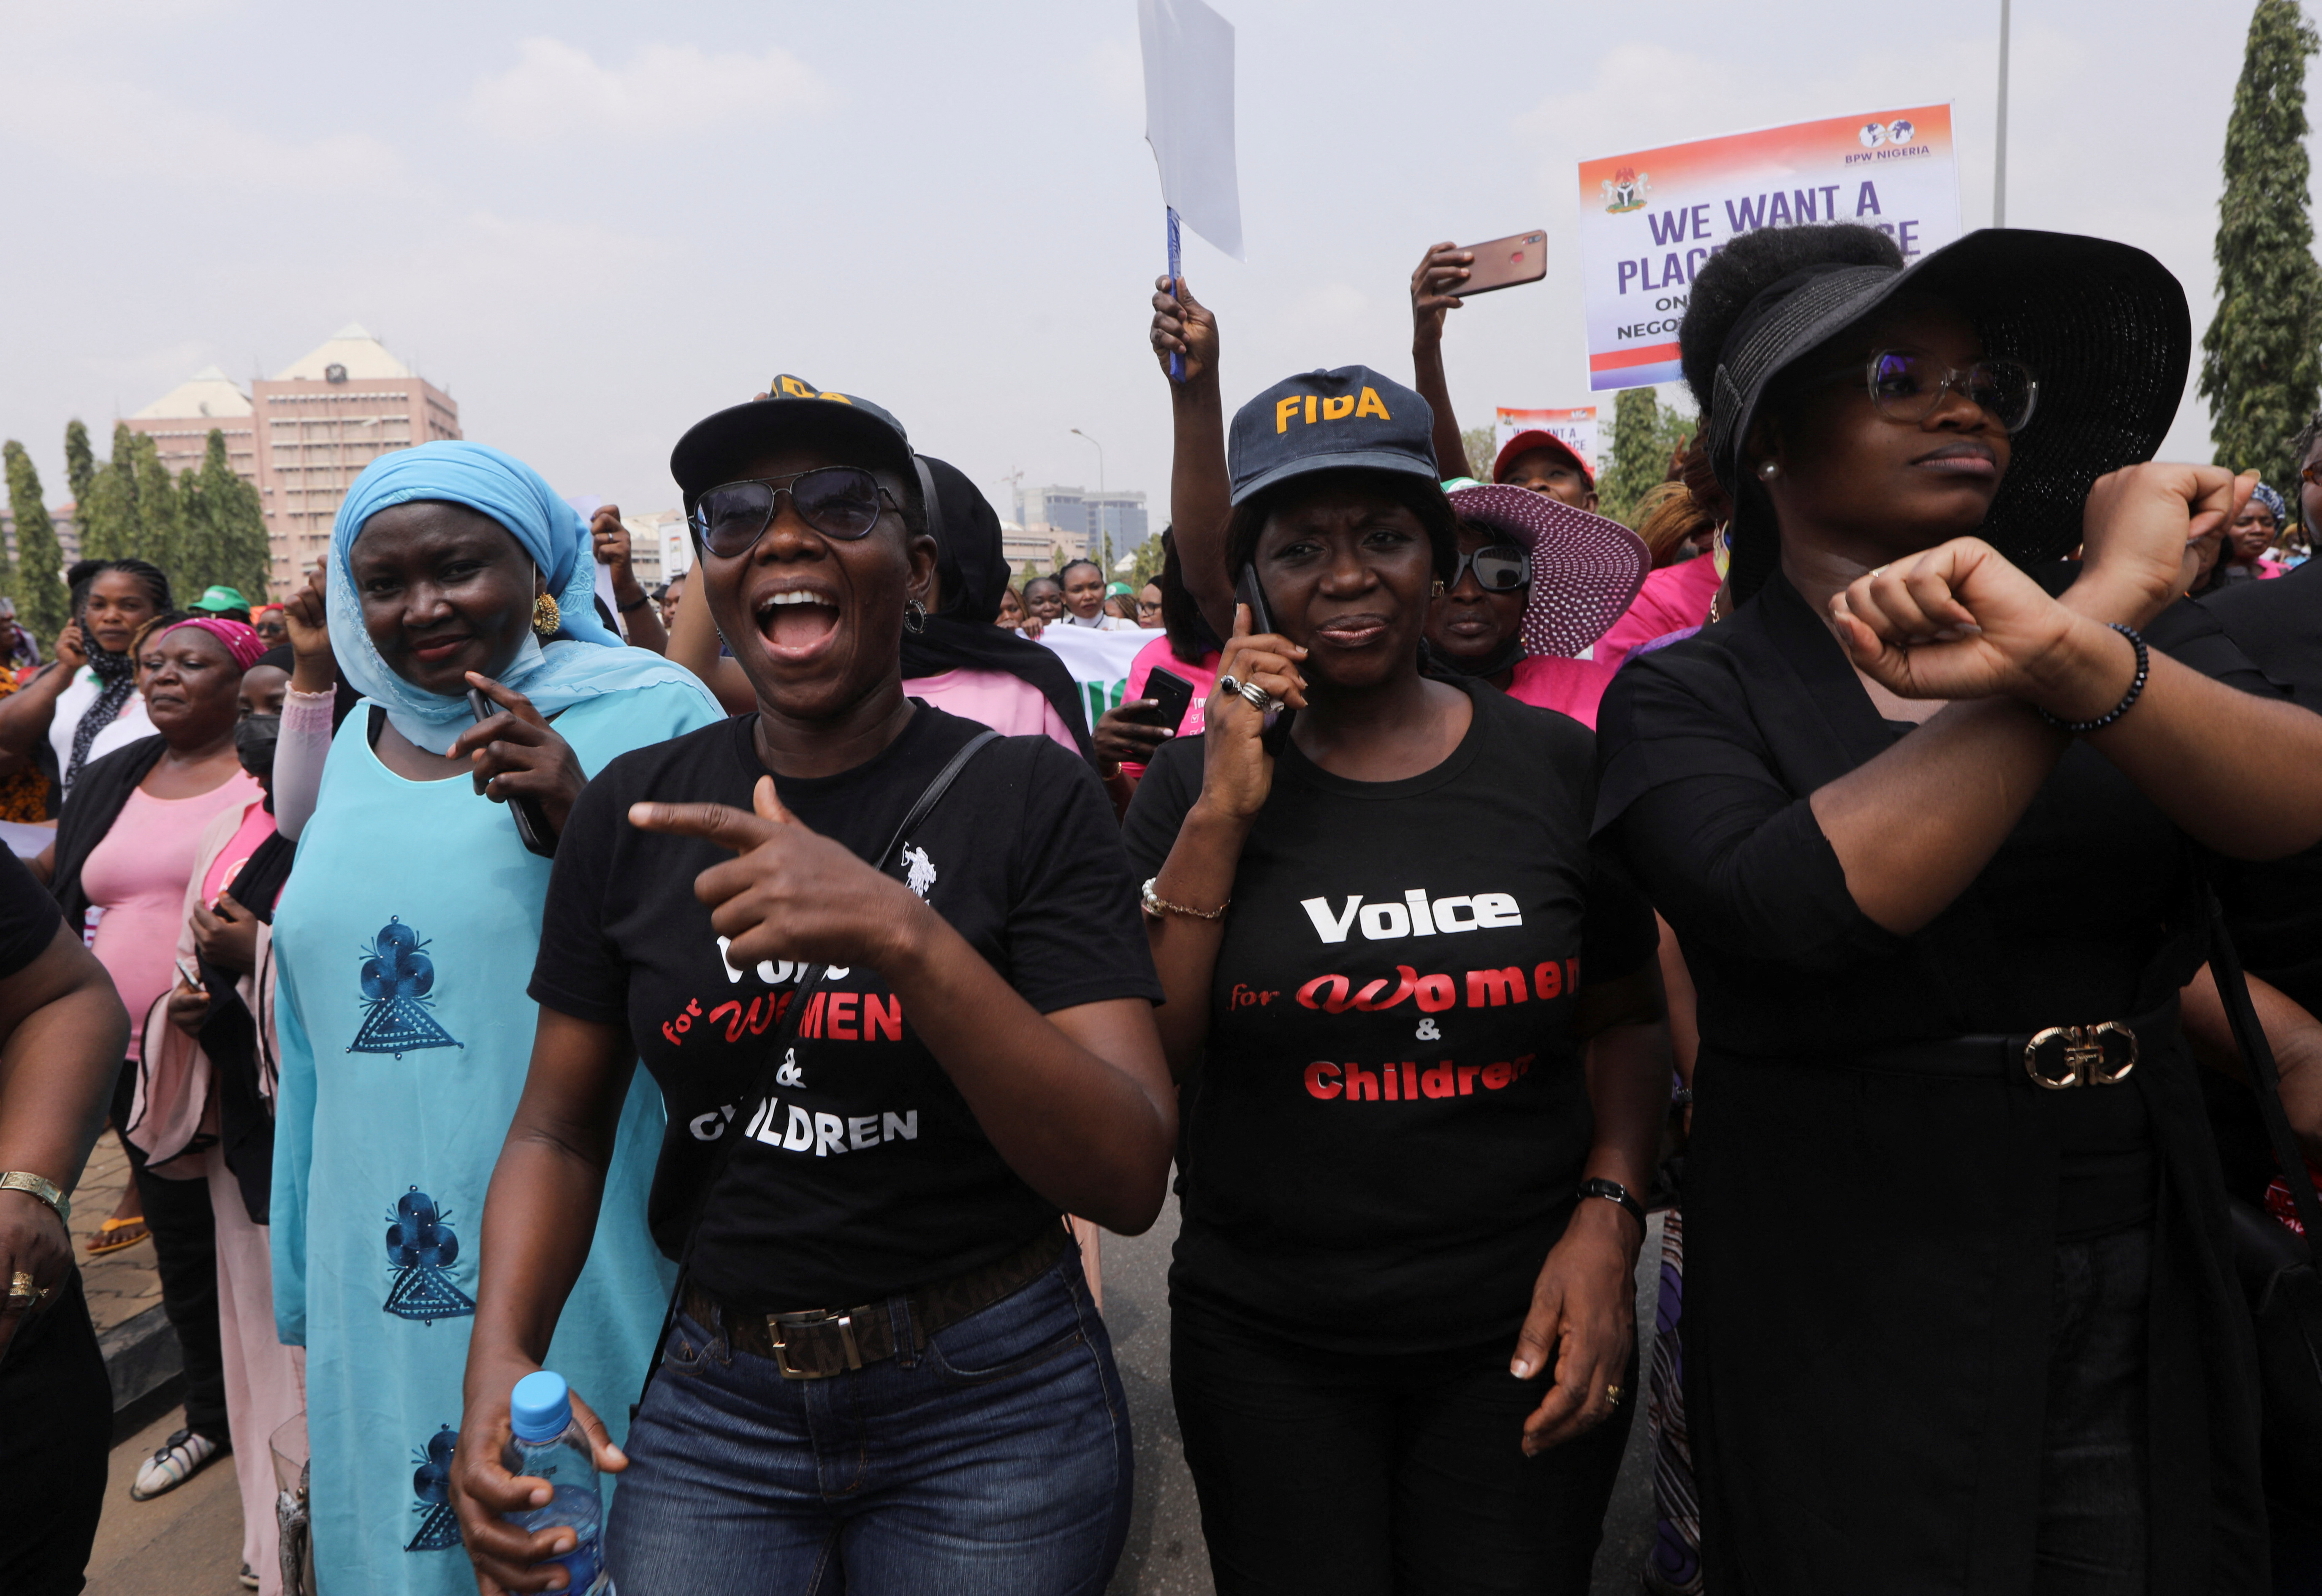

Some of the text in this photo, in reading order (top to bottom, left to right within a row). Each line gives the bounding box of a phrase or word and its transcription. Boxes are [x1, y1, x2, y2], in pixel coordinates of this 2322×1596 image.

[1845, 152, 1872, 164] BPW
[1877, 145, 1930, 160] NIGERIA
[1648, 181, 1881, 246] WE WANT A
[1618, 244, 1728, 295] PLAC
[1617, 317, 1684, 339] NEGO
[1276, 386, 1390, 434] FIDA
[1300, 888, 1522, 943] Voice
[1226, 983, 1280, 1011] for
[662, 998, 702, 1046] for
[1416, 1018, 1441, 1040] &
[776, 1048, 807, 1088] &
[1304, 1053, 1537, 1100] Children
